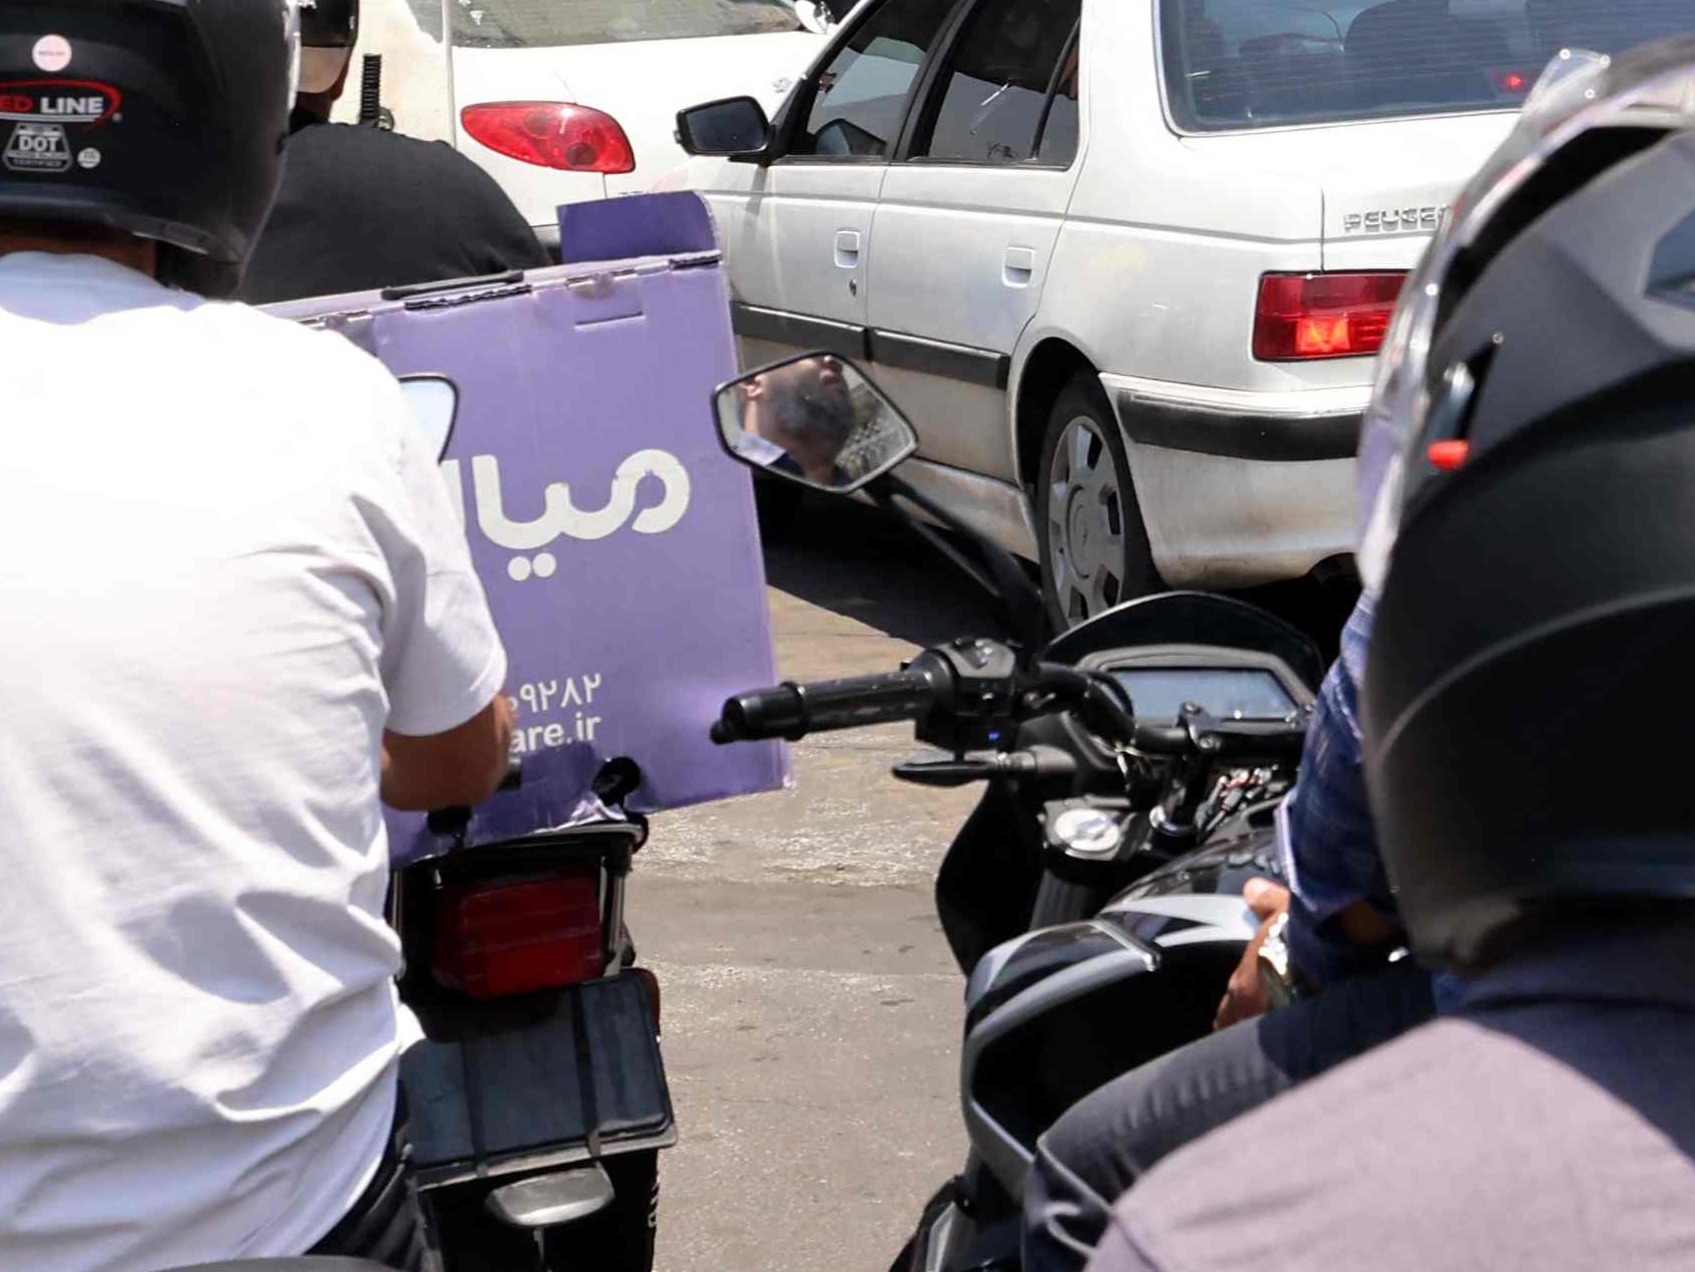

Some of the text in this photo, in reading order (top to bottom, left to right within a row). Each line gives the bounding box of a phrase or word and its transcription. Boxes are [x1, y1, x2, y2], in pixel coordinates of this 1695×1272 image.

[40, 96, 105, 115] LINE
[19, 136, 60, 152] DOT
[509, 711, 602, 753] are.ir
